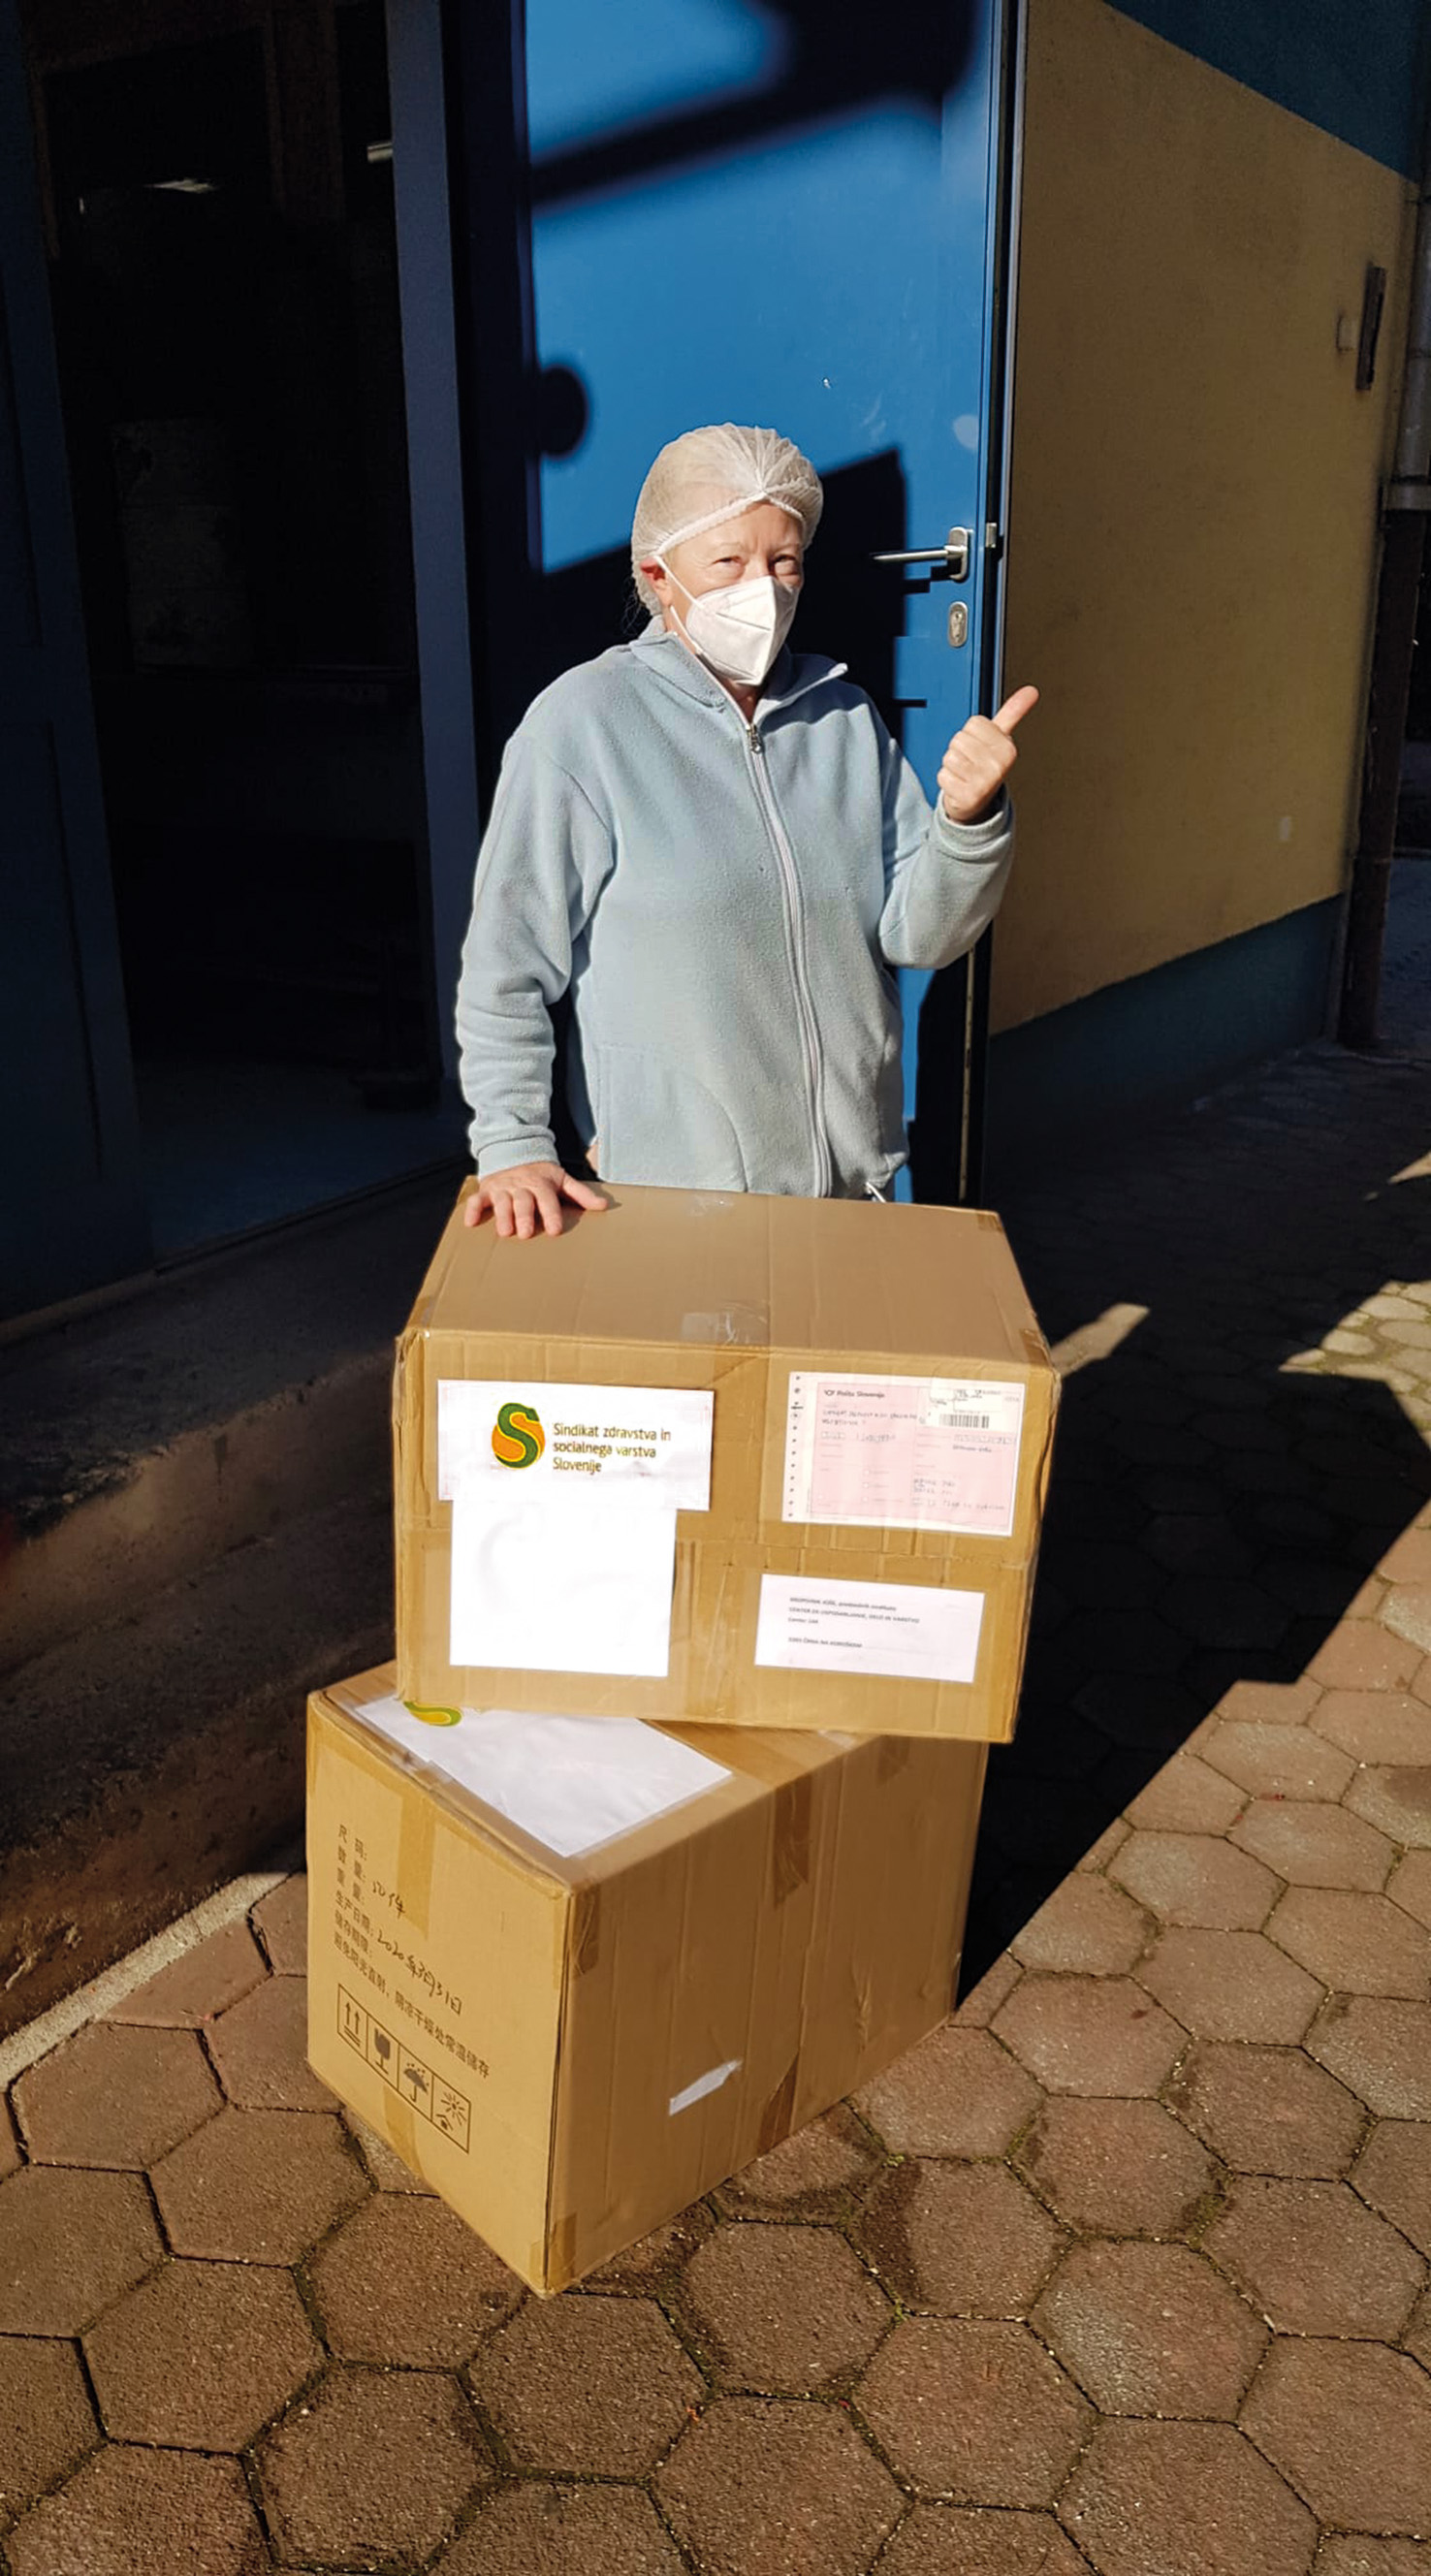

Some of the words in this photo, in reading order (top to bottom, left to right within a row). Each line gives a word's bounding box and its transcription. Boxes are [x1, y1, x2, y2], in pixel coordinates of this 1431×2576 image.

[553, 1422, 599, 1438] Sindikat
[603, 1426, 657, 1441] zdravstva
[660, 1427, 671, 1442] in
[553, 1441, 613, 1458] socialnega
[616, 1445, 656, 1458] varstva
[553, 1456, 602, 1476] Slovenije
